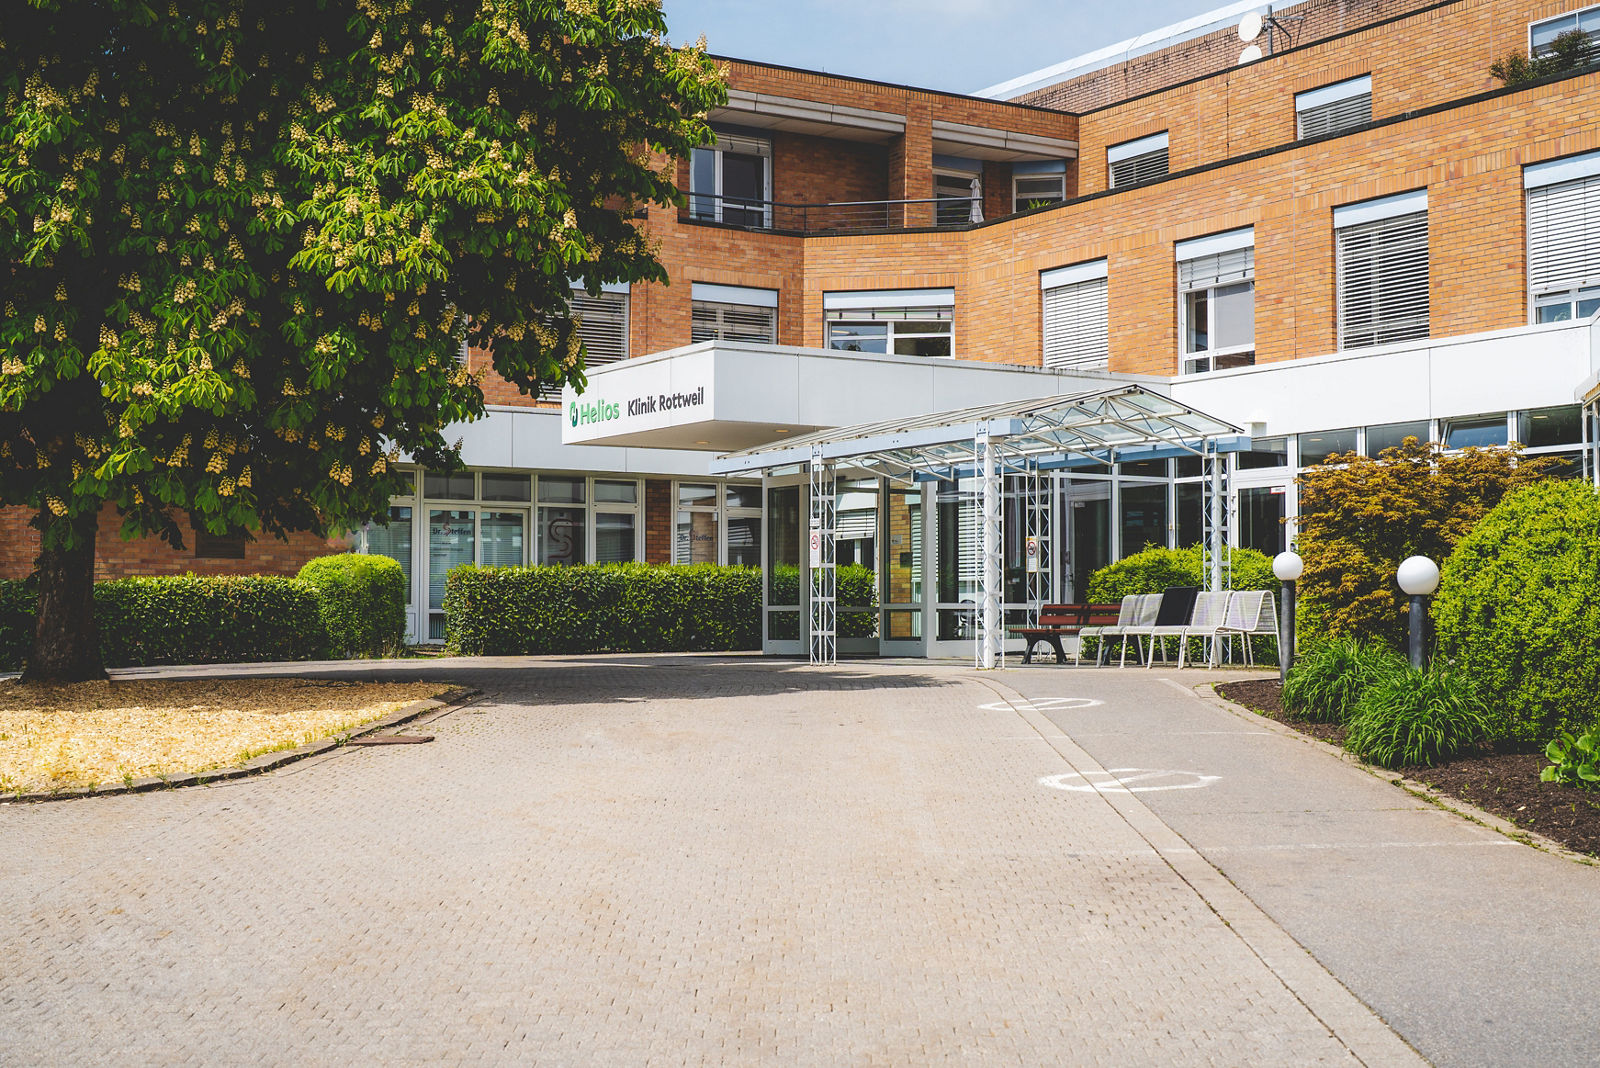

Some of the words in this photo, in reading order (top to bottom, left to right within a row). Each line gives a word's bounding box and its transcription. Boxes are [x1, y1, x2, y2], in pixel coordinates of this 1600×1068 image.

[580, 399, 619, 425] Helios
[627, 395, 657, 417] Klinik
[659, 386, 704, 411] Rottweil
